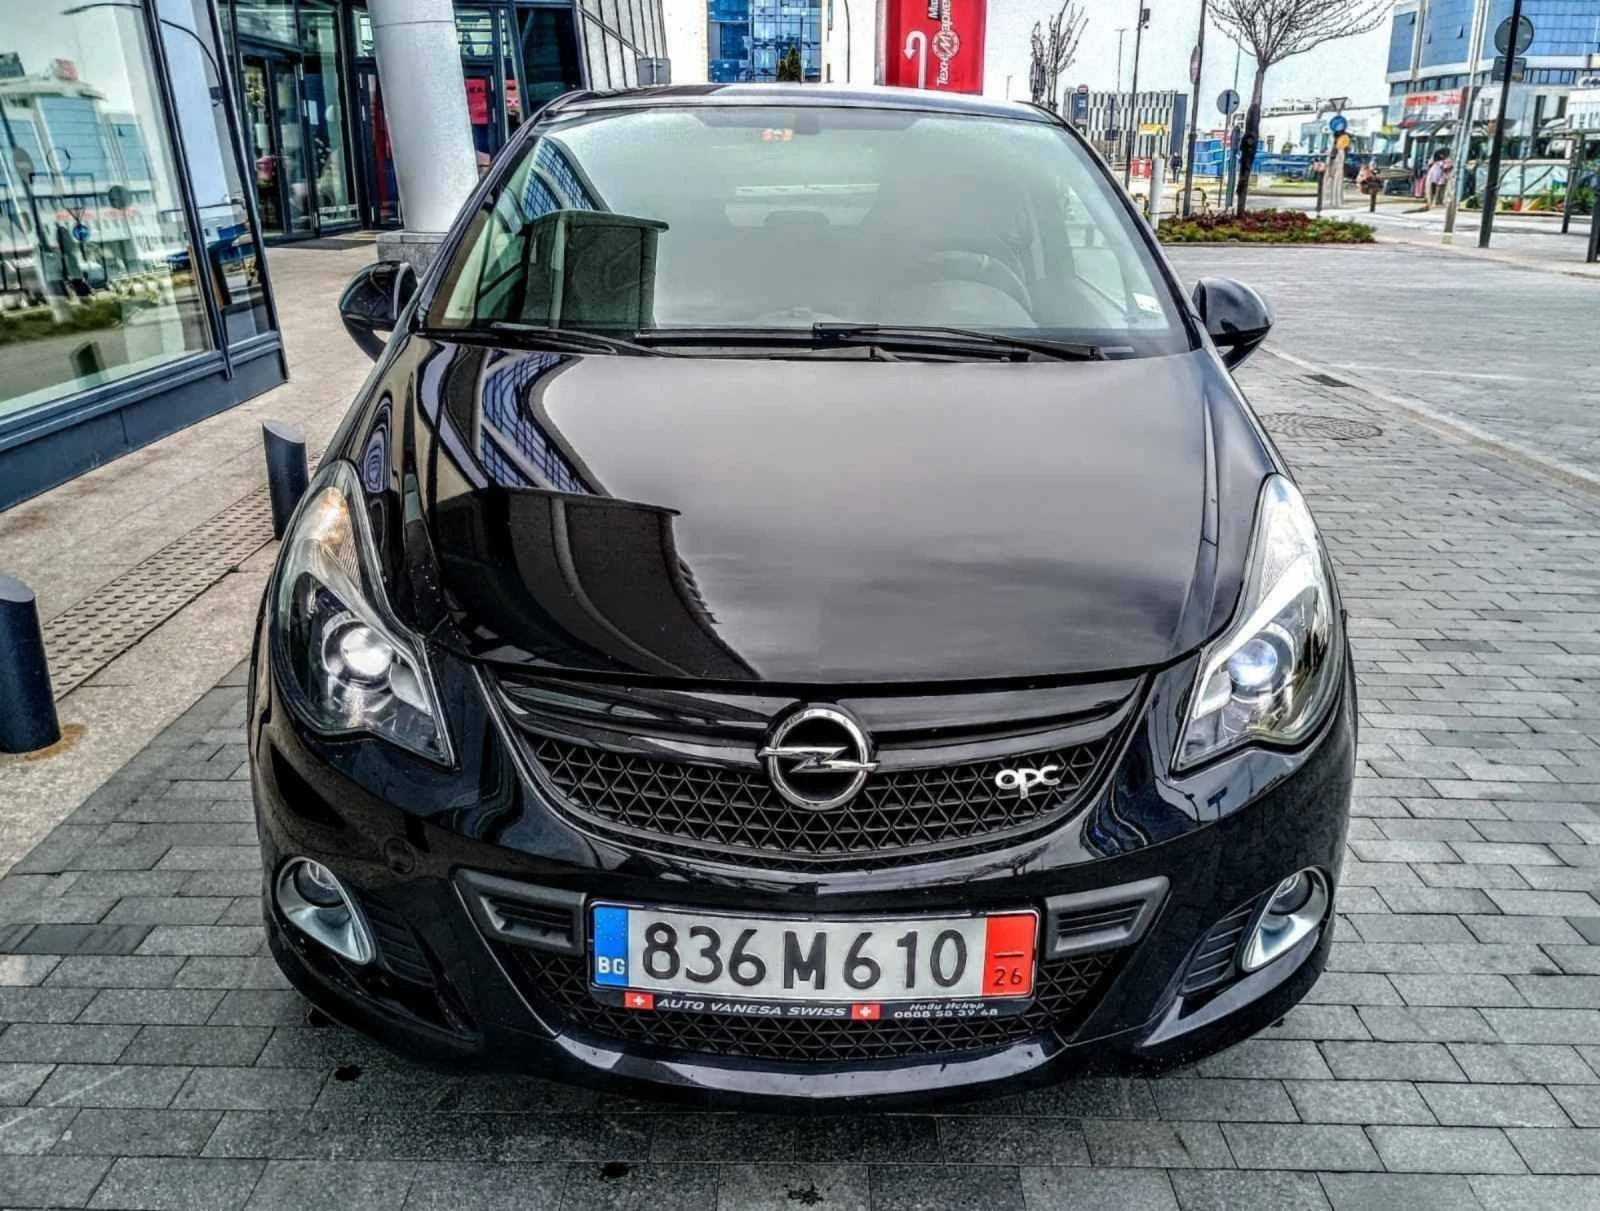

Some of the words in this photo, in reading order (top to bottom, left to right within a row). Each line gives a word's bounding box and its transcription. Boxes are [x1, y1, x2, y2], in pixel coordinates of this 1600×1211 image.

[598, 956, 625, 975] BG
[643, 922, 766, 986] 836
[843, 929, 967, 990] 610
[993, 966, 1022, 987] 26
[657, 999, 704, 1010] AUTO
[711, 1002, 782, 1015] VANESA
[788, 1006, 847, 1017] SWISS
[957, 1009, 975, 1017] 39
